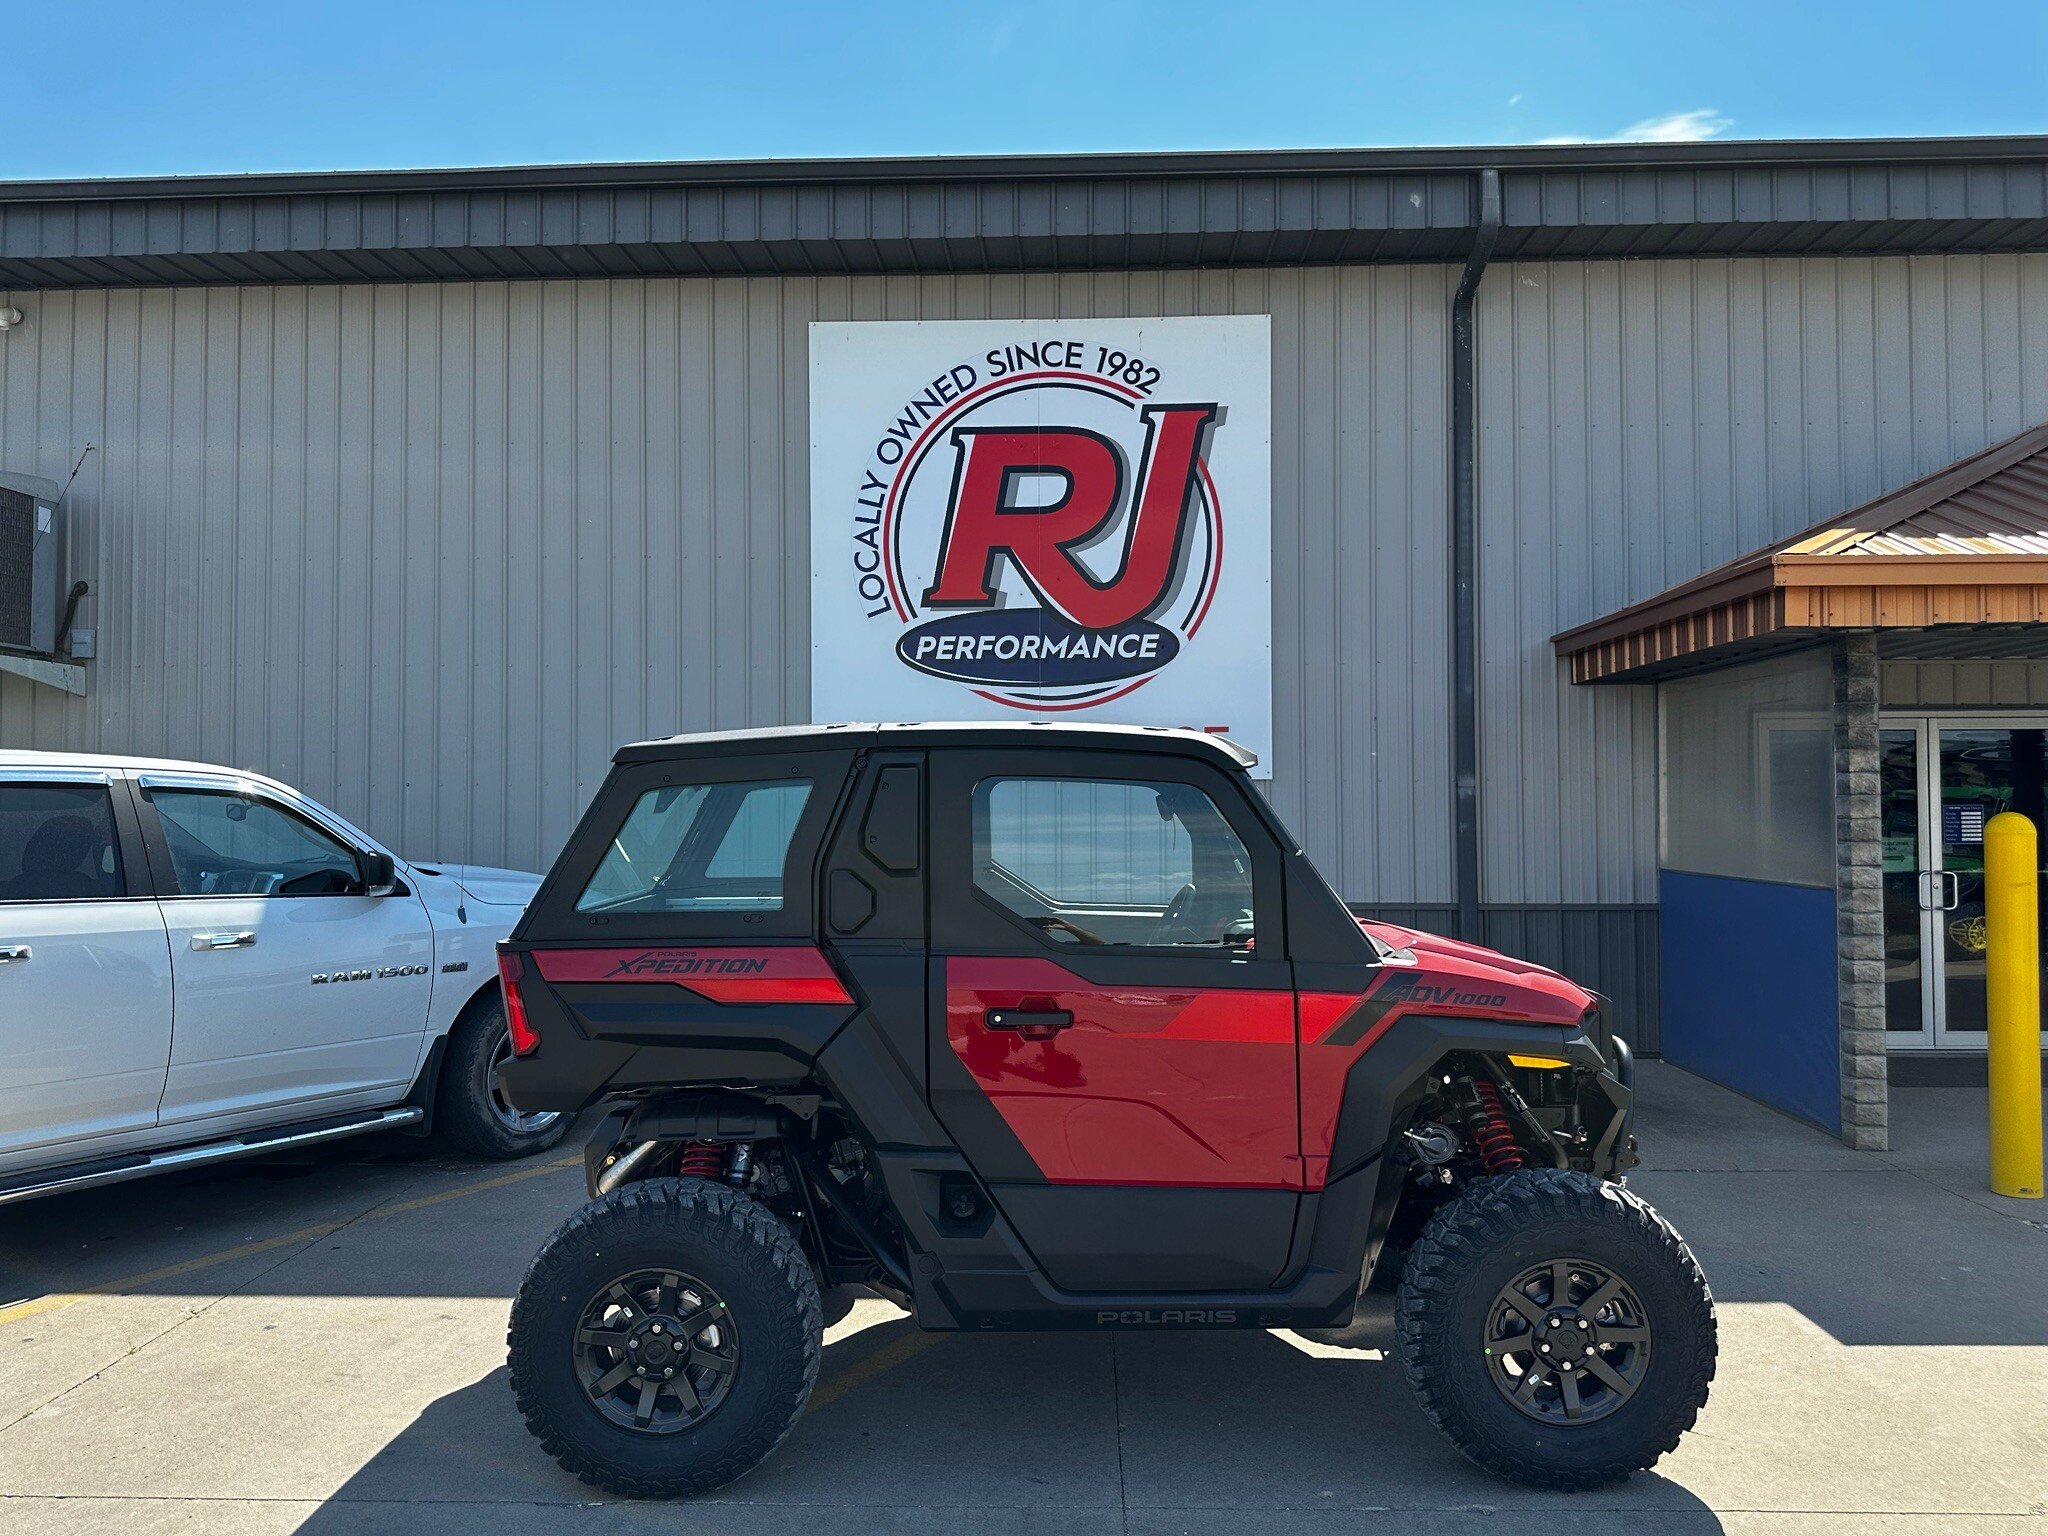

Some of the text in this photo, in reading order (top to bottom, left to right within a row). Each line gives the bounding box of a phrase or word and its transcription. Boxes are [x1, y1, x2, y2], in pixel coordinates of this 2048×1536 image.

[853, 340, 1161, 618] LOCALLY OWNED SINCE 1982
[920, 402, 1219, 630] RJ
[915, 633, 1160, 660] PERFORMANCE
[311, 970, 372, 985] RAM
[376, 963, 429, 979] 1500
[602, 951, 769, 979] XPEDITION
[1097, 1309, 1237, 1325] POLARIS
